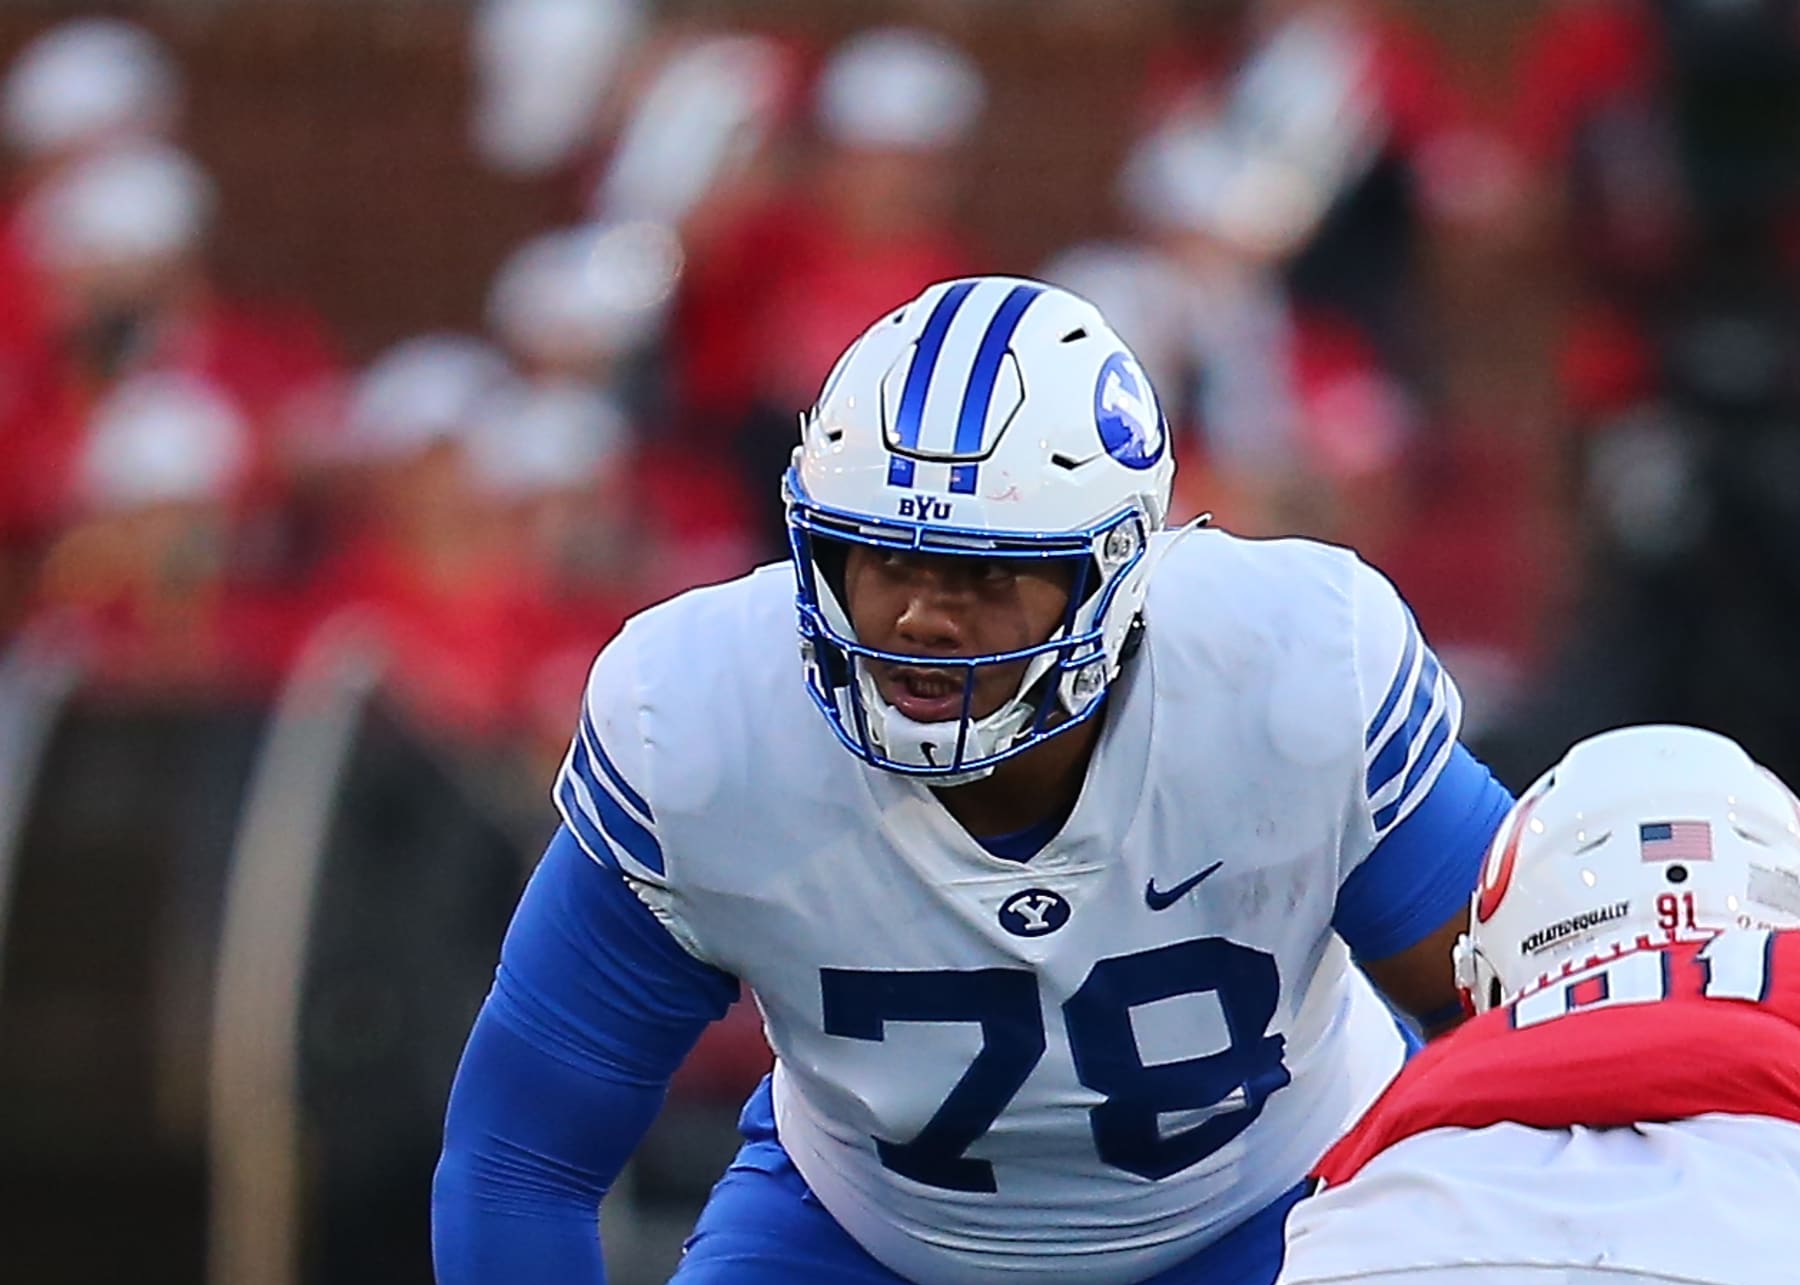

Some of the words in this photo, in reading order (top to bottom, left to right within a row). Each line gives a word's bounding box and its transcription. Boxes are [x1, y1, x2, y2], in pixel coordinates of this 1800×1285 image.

[899, 495, 952, 521] BYU
[1008, 895, 1057, 930] Y
[1656, 891, 1696, 930] 91
[819, 937, 1291, 1193] 78
